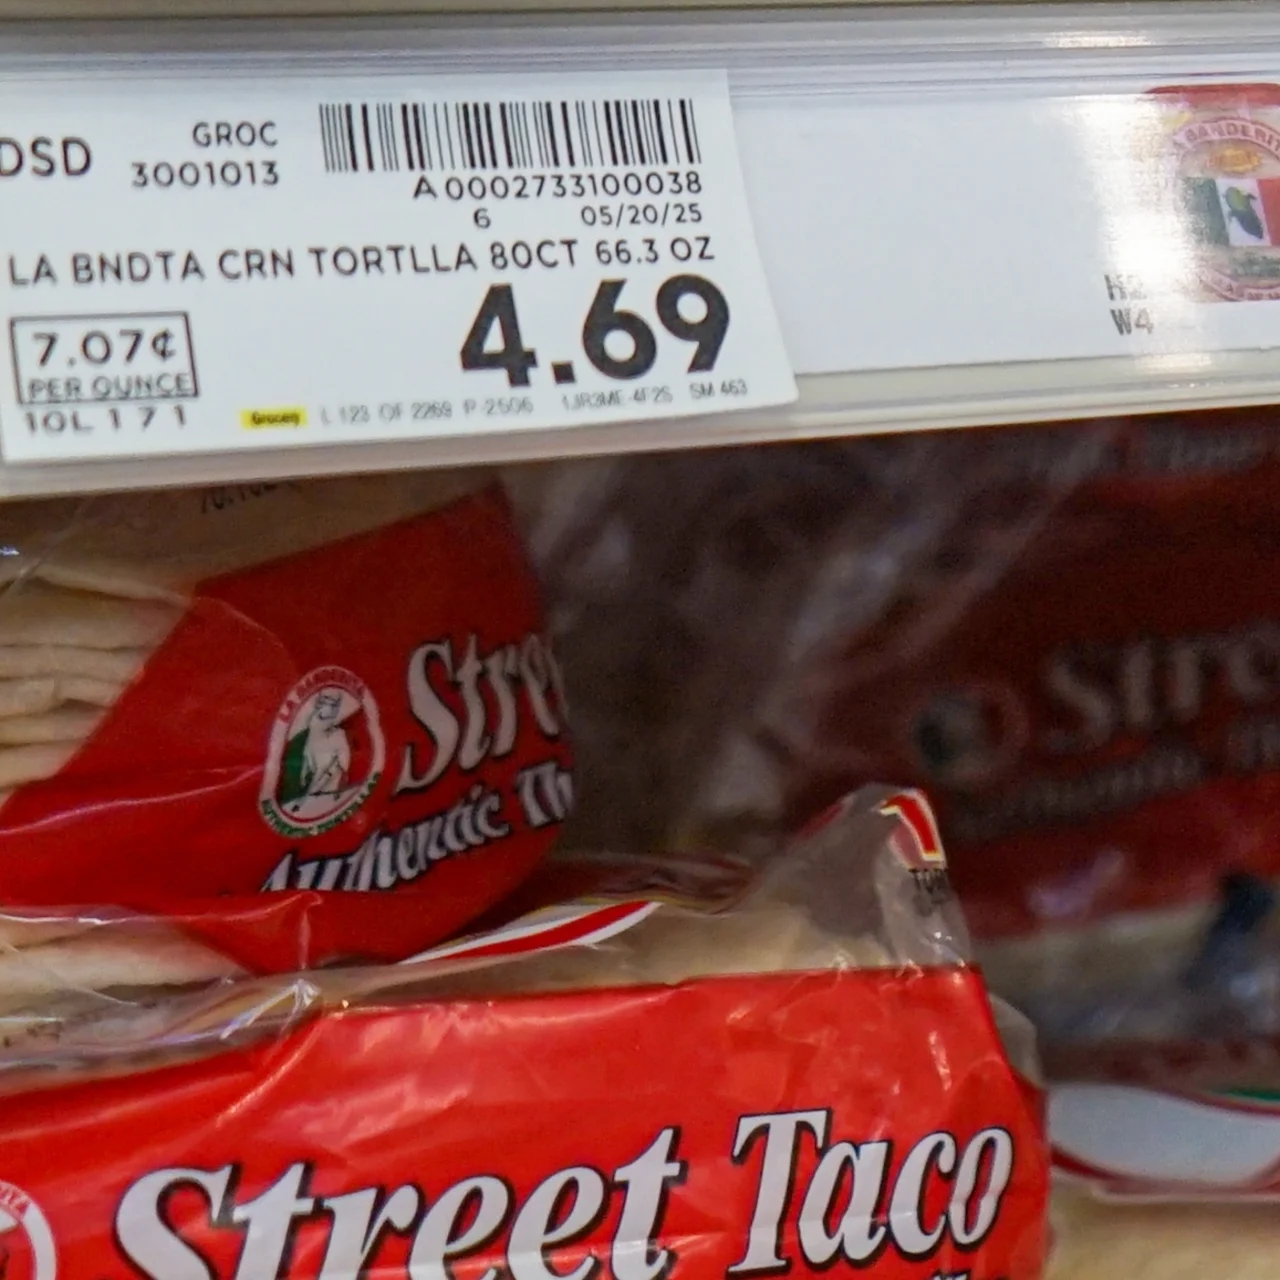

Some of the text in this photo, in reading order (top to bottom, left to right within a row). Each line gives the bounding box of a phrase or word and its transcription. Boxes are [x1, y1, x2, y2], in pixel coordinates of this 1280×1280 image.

[192, 121, 278, 148] GROC
[0, 137, 92, 178] DSD
[131, 160, 279, 188] 3001013
[473, 202, 703, 230] 6 05/20/25
[9, 235, 716, 286] LA BNDTA CRN TORTLLA 80CT 66.3 OZ
[33, 327, 176, 368] 7.07¢
[459, 272, 731, 388] 4.69
[28, 371, 191, 403] PER OUNCE
[112, 1107, 1013, 1280] Street Taco
